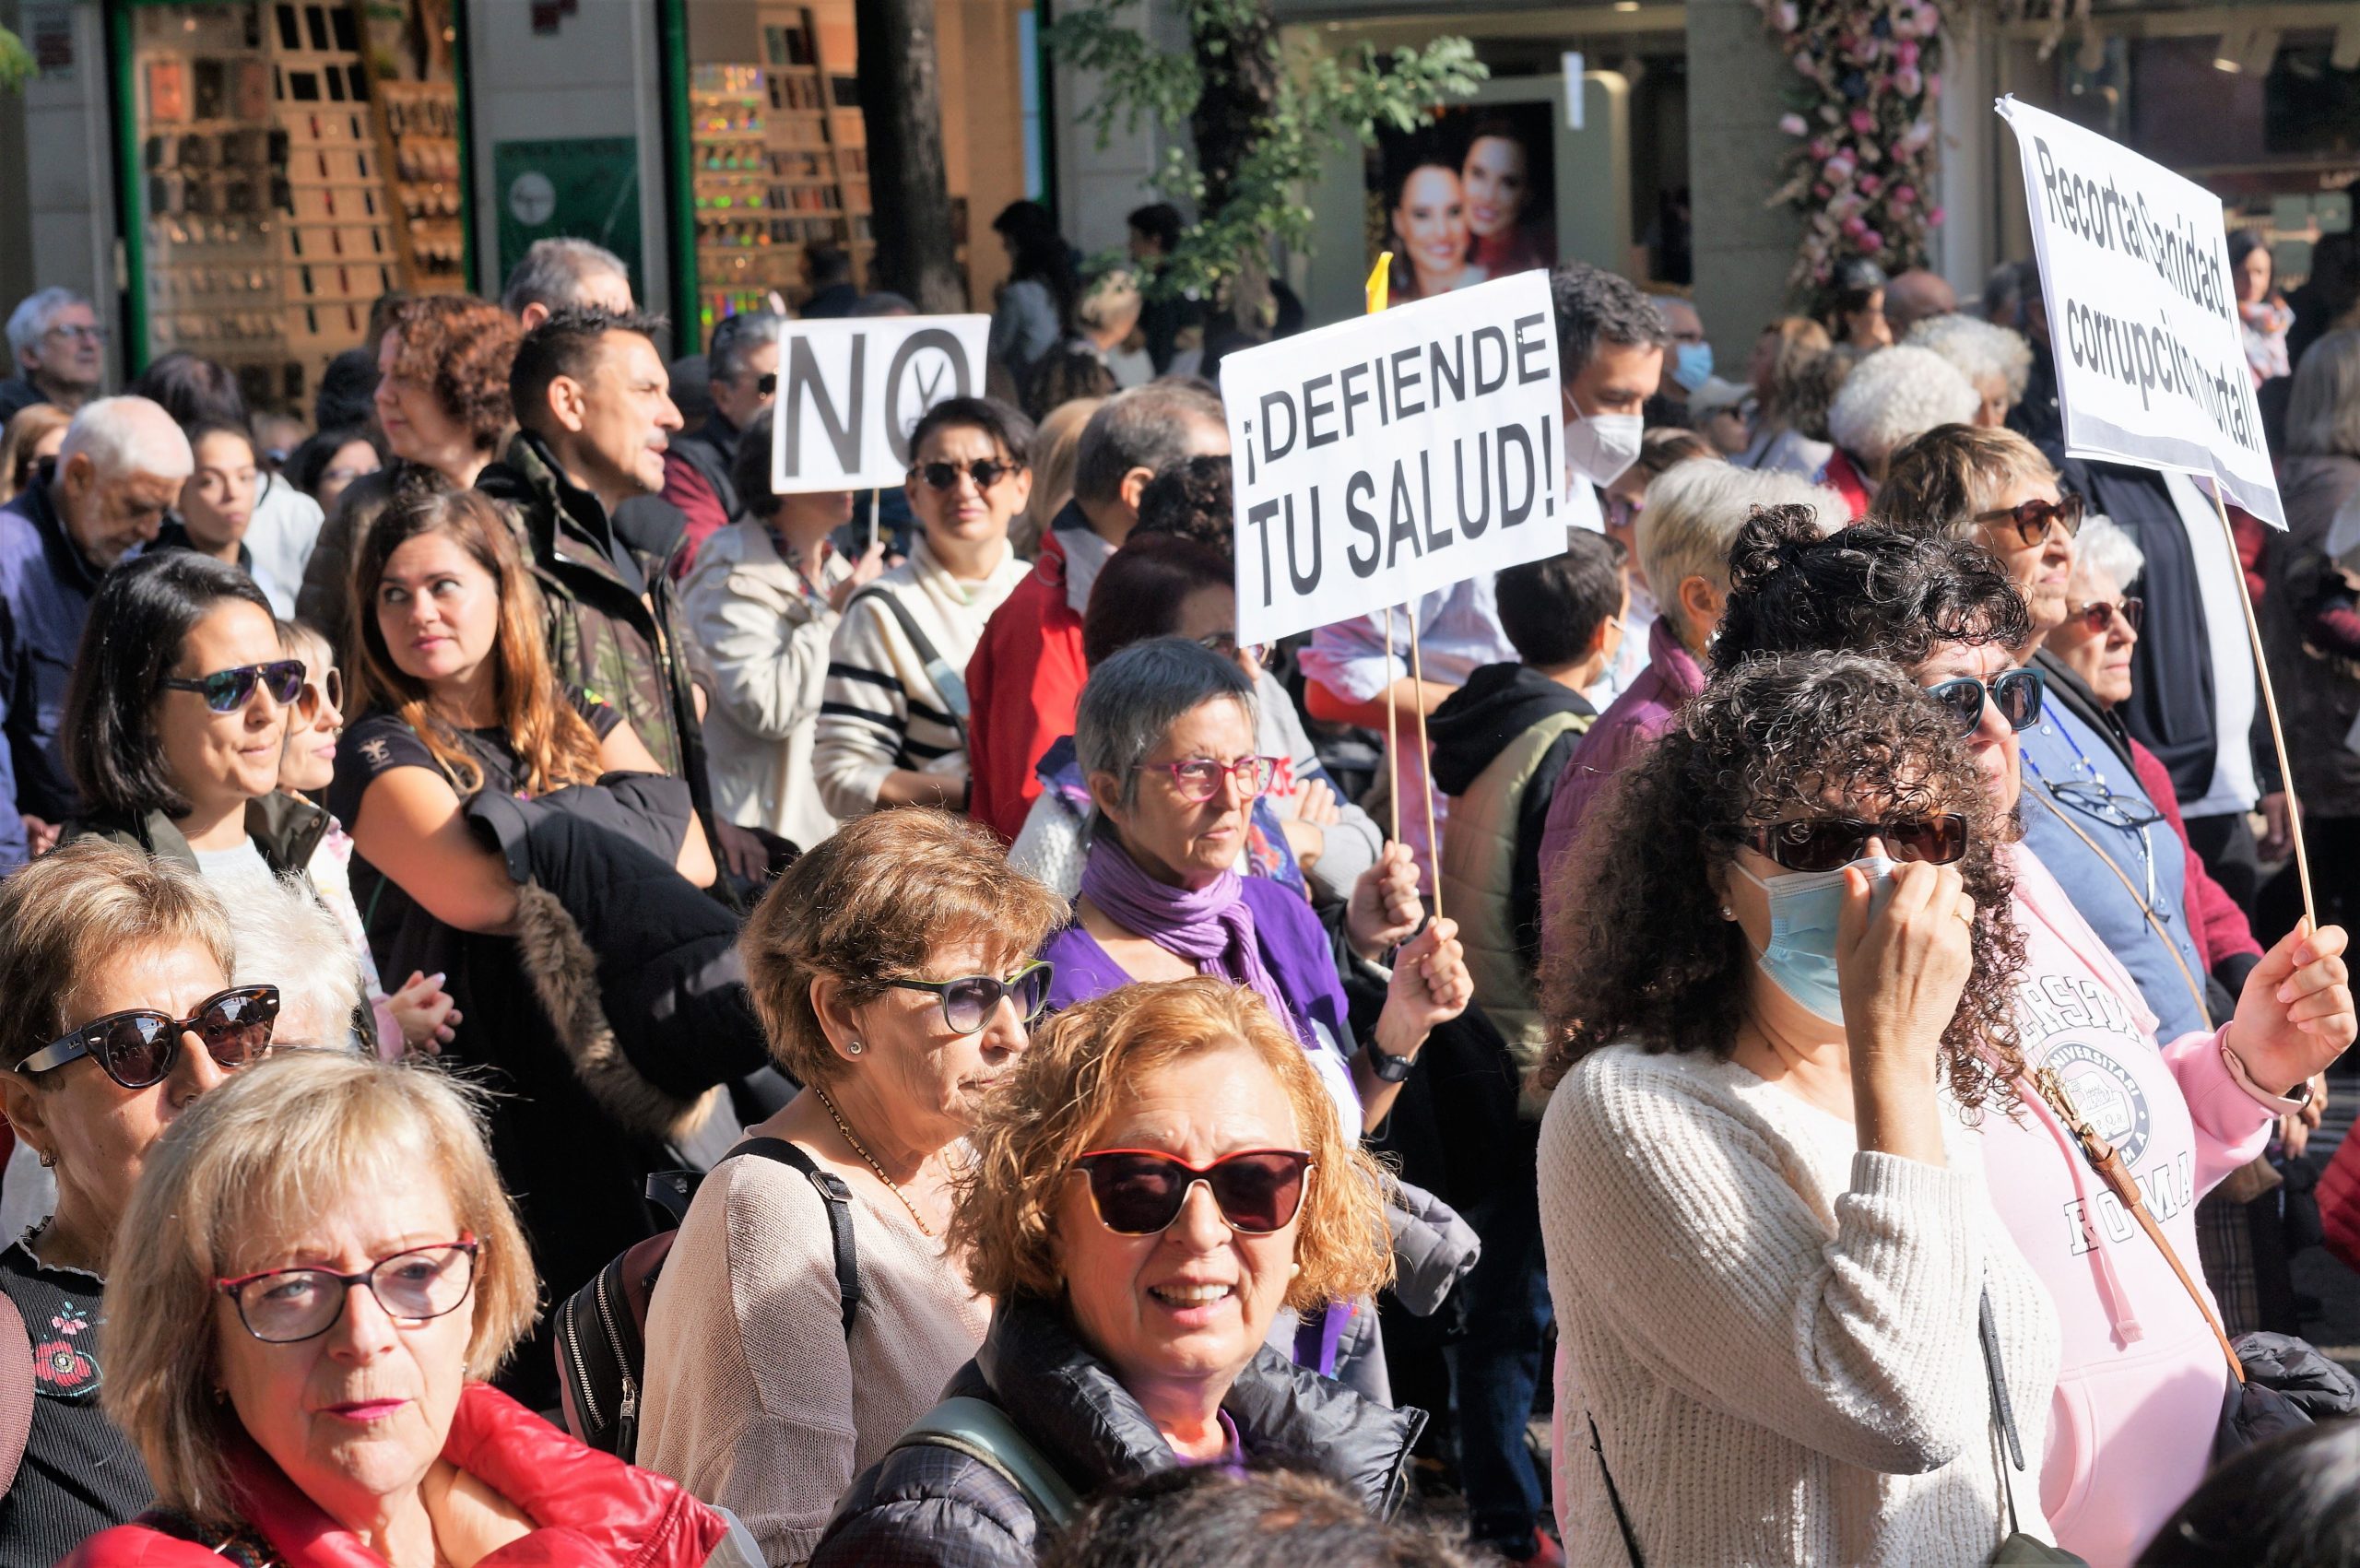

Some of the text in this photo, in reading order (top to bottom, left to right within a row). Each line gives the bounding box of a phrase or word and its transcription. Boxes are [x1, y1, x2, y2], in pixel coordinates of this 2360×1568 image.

[2137, 191, 2236, 341] Sanidad,
[785, 328, 972, 477] NO
[1244, 312, 1551, 486] ¡DEFIENDE
[1248, 415, 1554, 607] TU SALUD!
[2048, 1045, 2141, 1097] NIVERSITARI
[2063, 1150, 2191, 1256] ROMA
